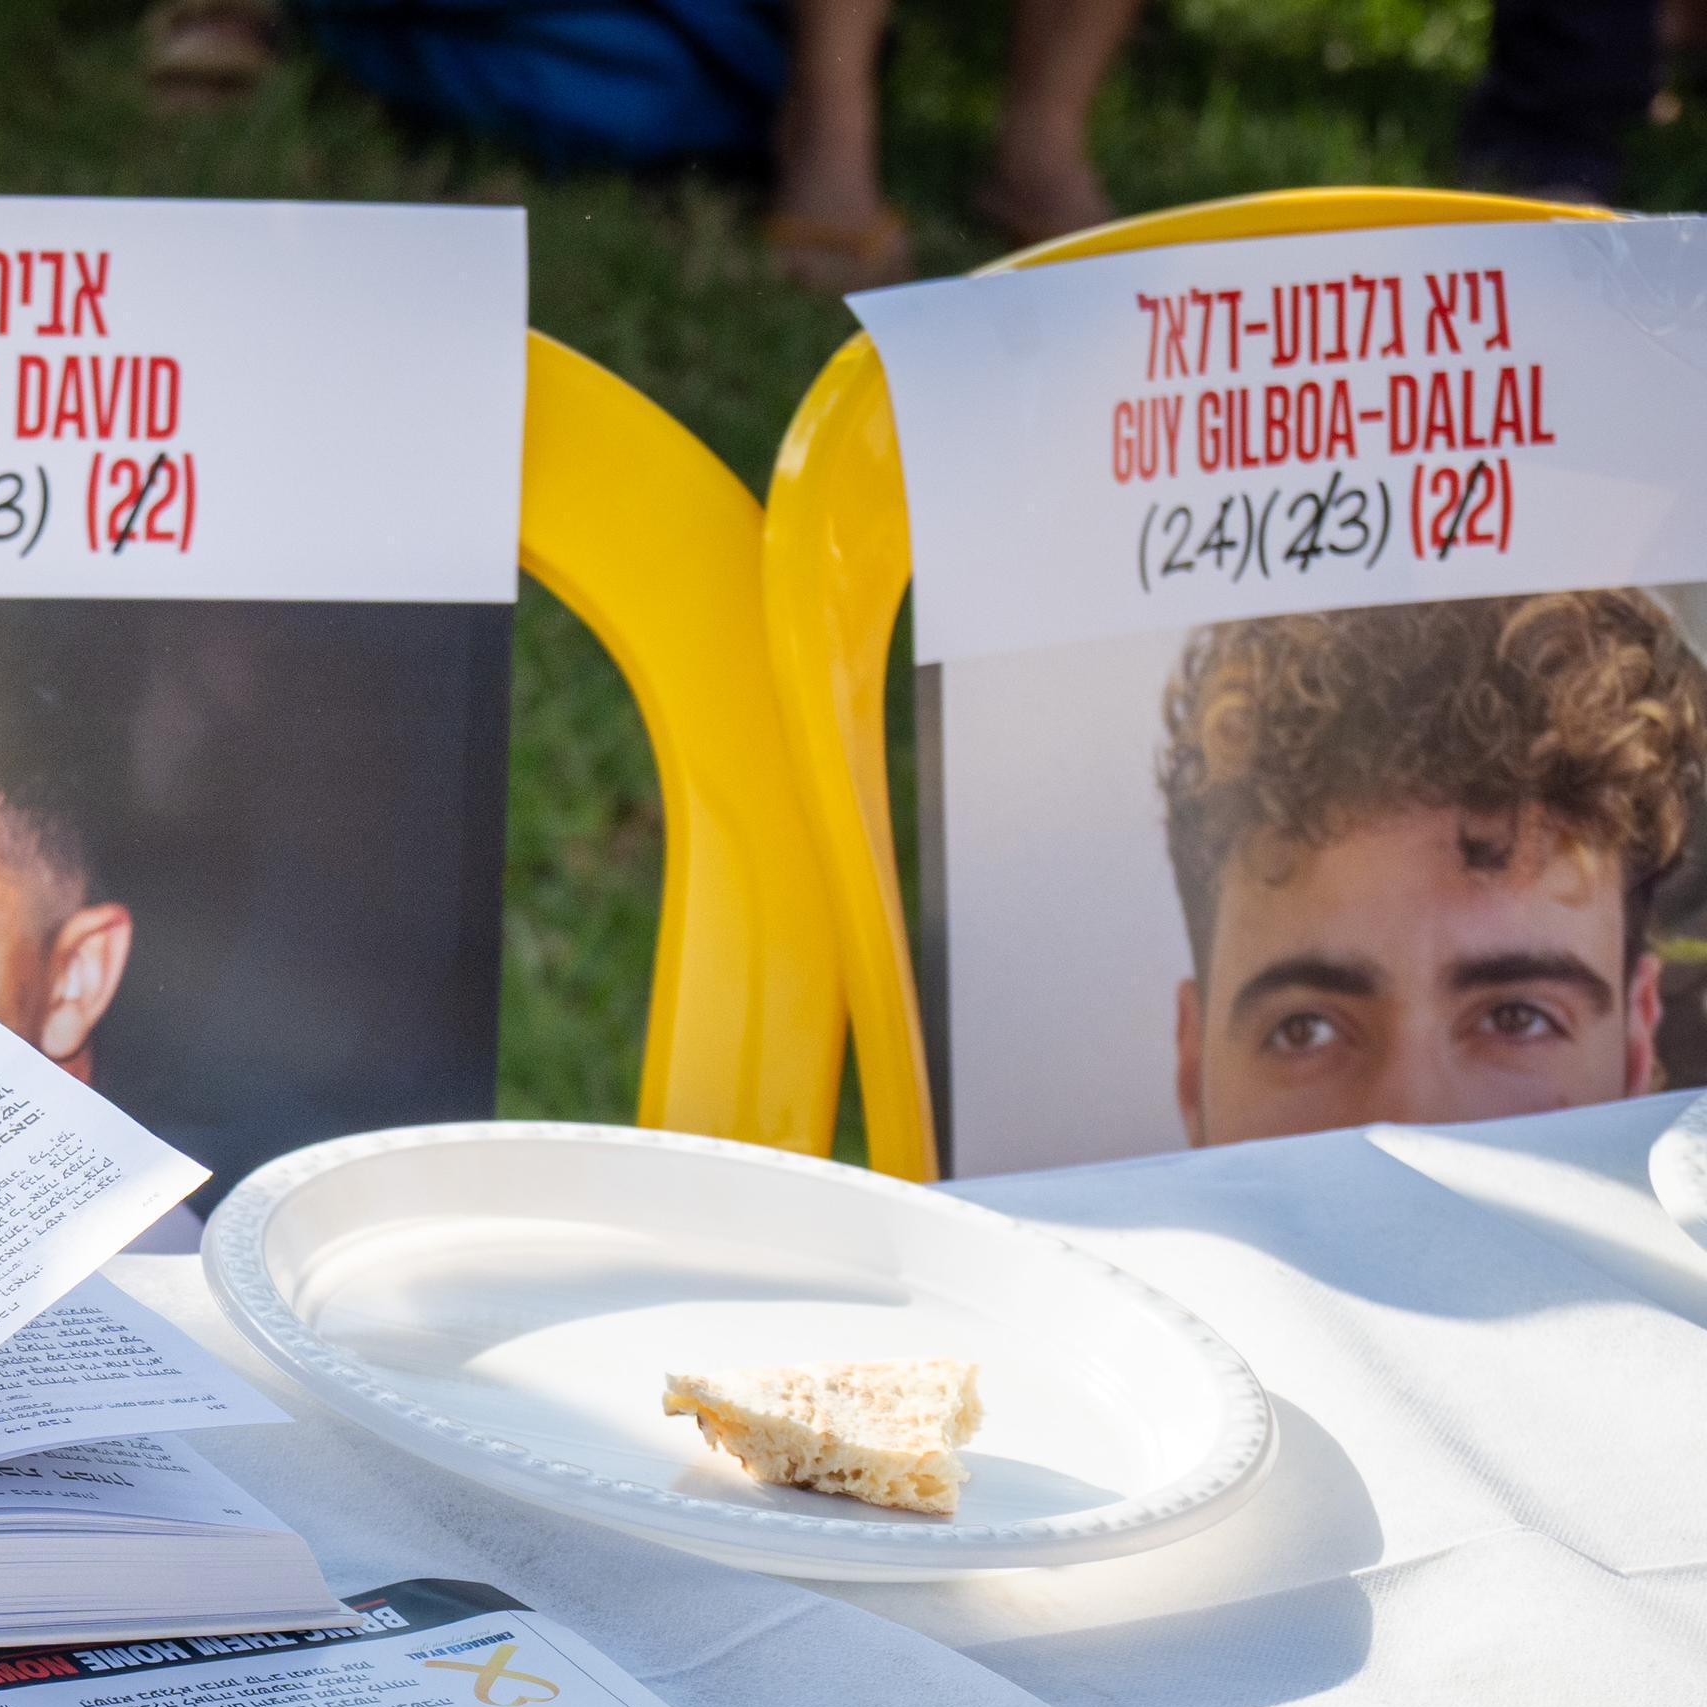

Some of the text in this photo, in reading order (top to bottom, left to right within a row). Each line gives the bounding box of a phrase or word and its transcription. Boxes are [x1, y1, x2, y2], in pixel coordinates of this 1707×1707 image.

[1426, 270, 1510, 354] גיא
[16, 355, 180, 440] DAVID
[1114, 365, 1555, 484] GUY GILBOA-DALAL
[73, 1641, 189, 1671] HOME
[188, 1631, 299, 1656] THEM
